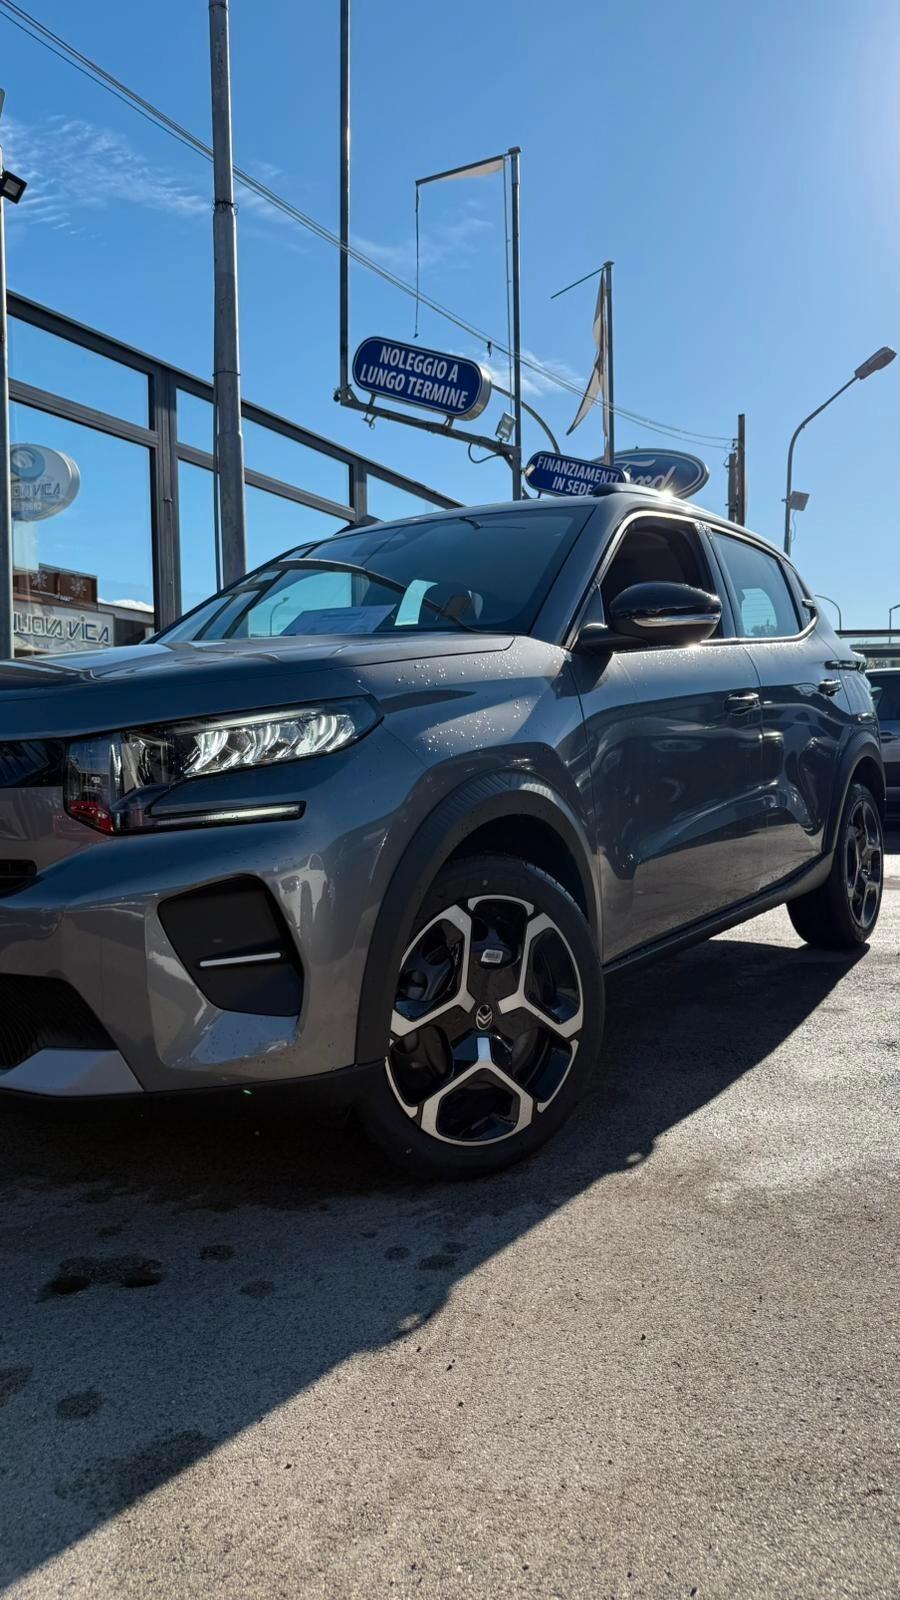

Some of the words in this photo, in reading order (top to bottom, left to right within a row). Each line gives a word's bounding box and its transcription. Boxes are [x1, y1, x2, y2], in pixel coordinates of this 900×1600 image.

[379, 345, 448, 379] NOLEGGIO
[448, 364, 459, 383] A
[360, 363, 406, 391] LUNGO
[407, 376, 469, 409] TERMINE
[536, 456, 620, 483] FINANZIAMENTI
[552, 476, 565, 490] IN
[566, 480, 594, 496] SEDE
[13, 612, 63, 638] UOVA
